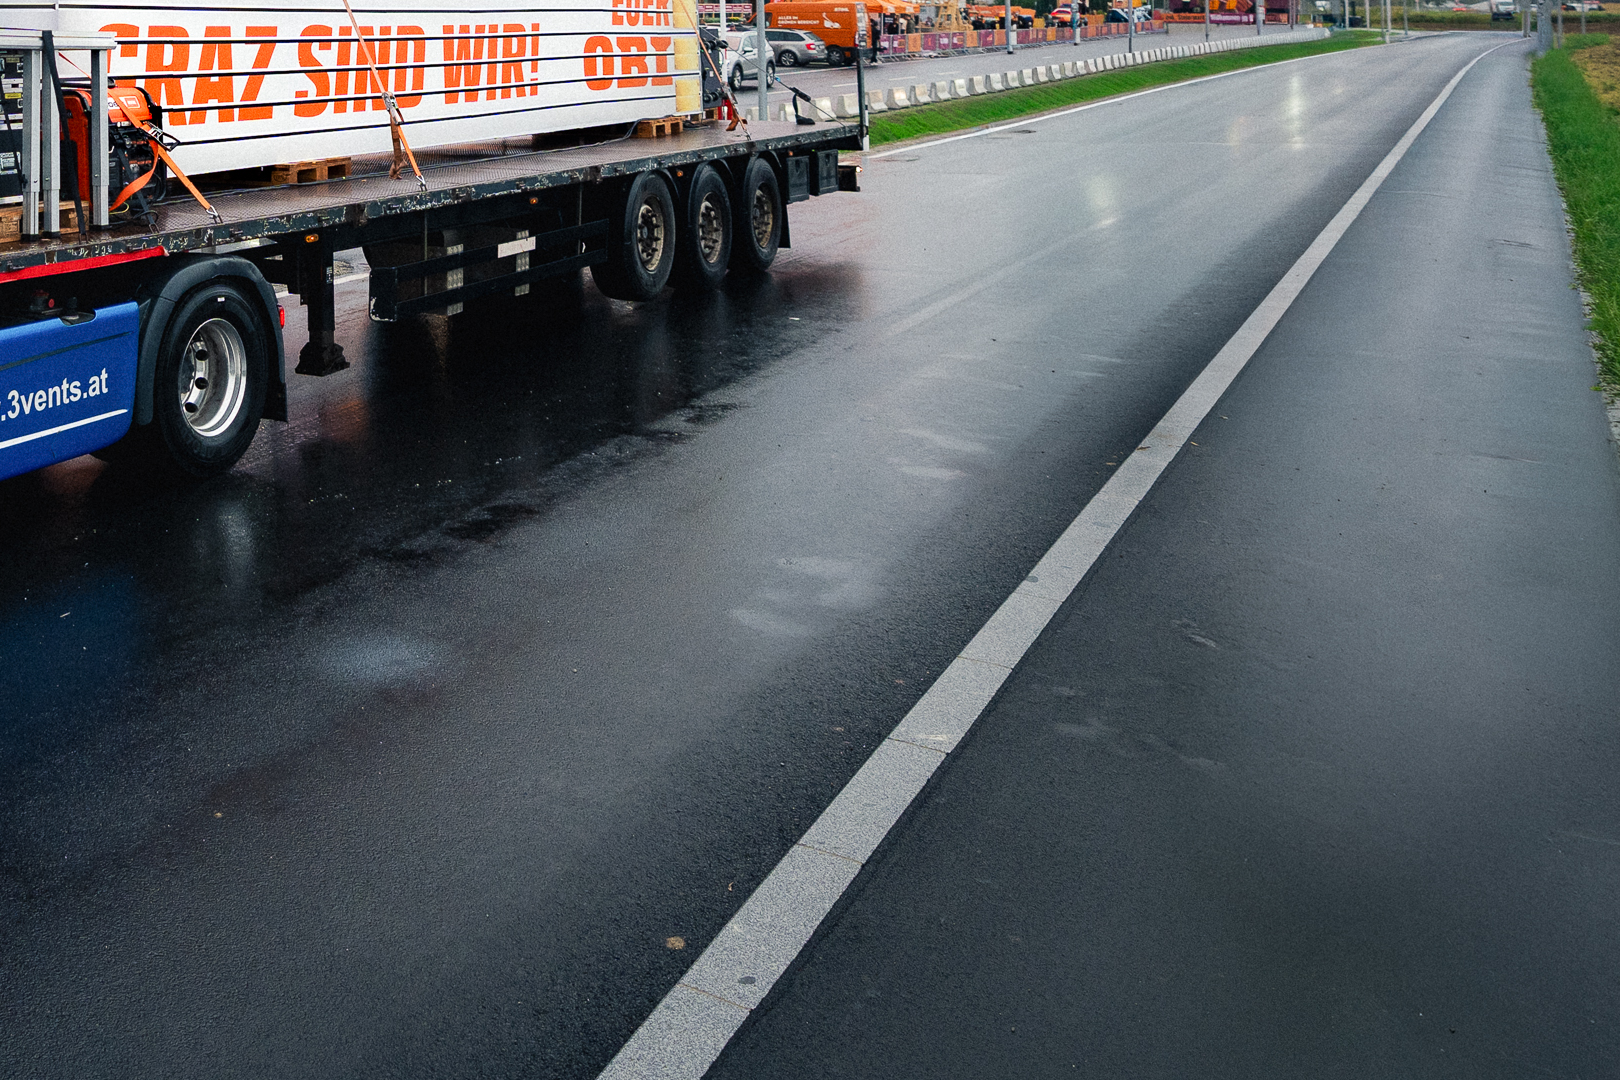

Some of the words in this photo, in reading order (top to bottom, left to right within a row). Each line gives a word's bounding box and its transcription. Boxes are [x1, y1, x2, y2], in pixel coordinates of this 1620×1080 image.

[293, 24, 426, 118] SIND
[443, 23, 540, 105] WIR!
[583, 36, 673, 91] OBI
